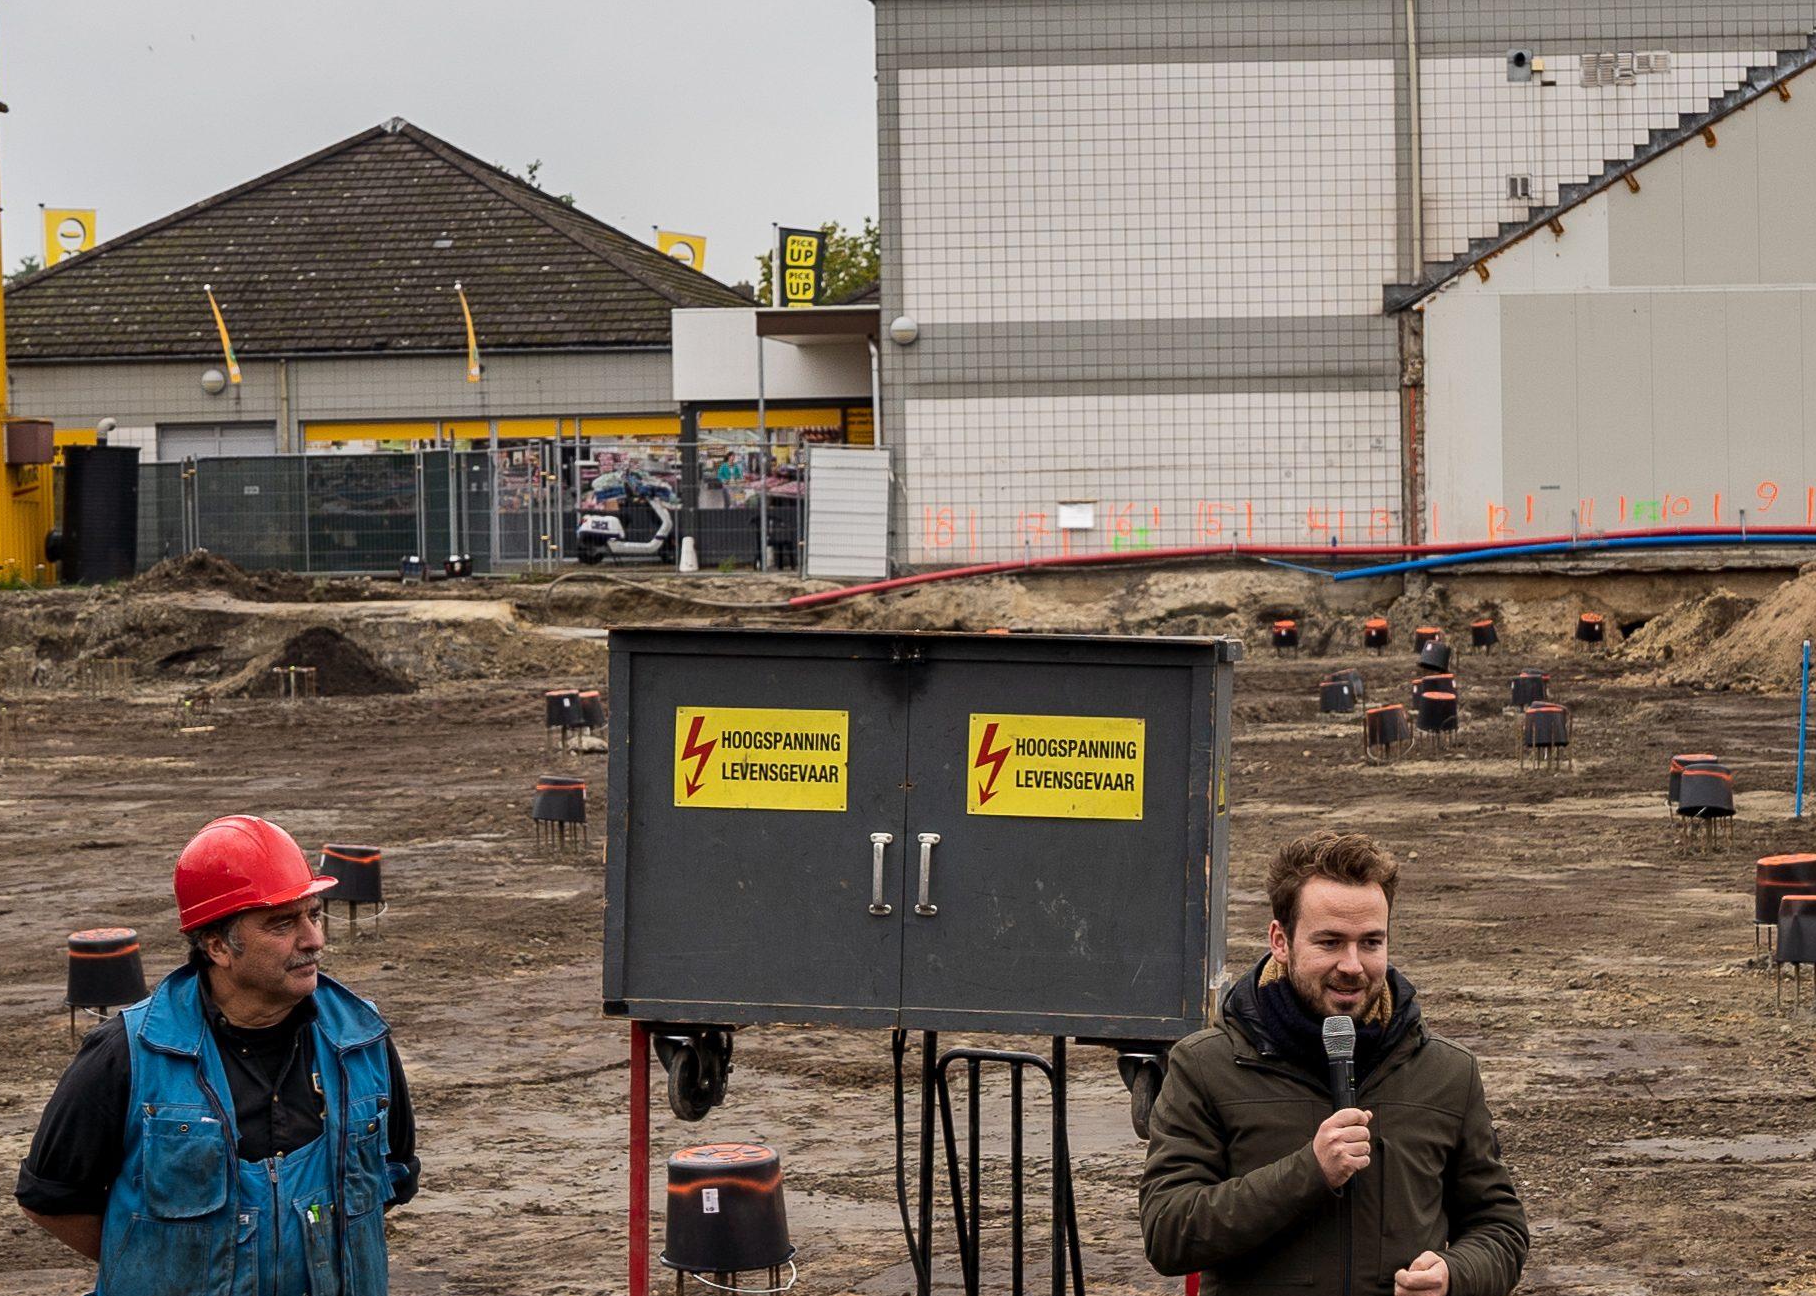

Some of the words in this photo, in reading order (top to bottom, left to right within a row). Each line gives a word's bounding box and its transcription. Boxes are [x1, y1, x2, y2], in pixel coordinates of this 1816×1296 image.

[790, 249, 813, 263] UP
[789, 282, 812, 296] UP
[1757, 481, 1778, 511] 9
[721, 730, 841, 752] HOOGSPANNING
[1015, 737, 1137, 760] HOOGSPANNING
[721, 762, 839, 783] LEVENSGEVAAR
[1015, 769, 1135, 792] LEVENSGEVAAR
